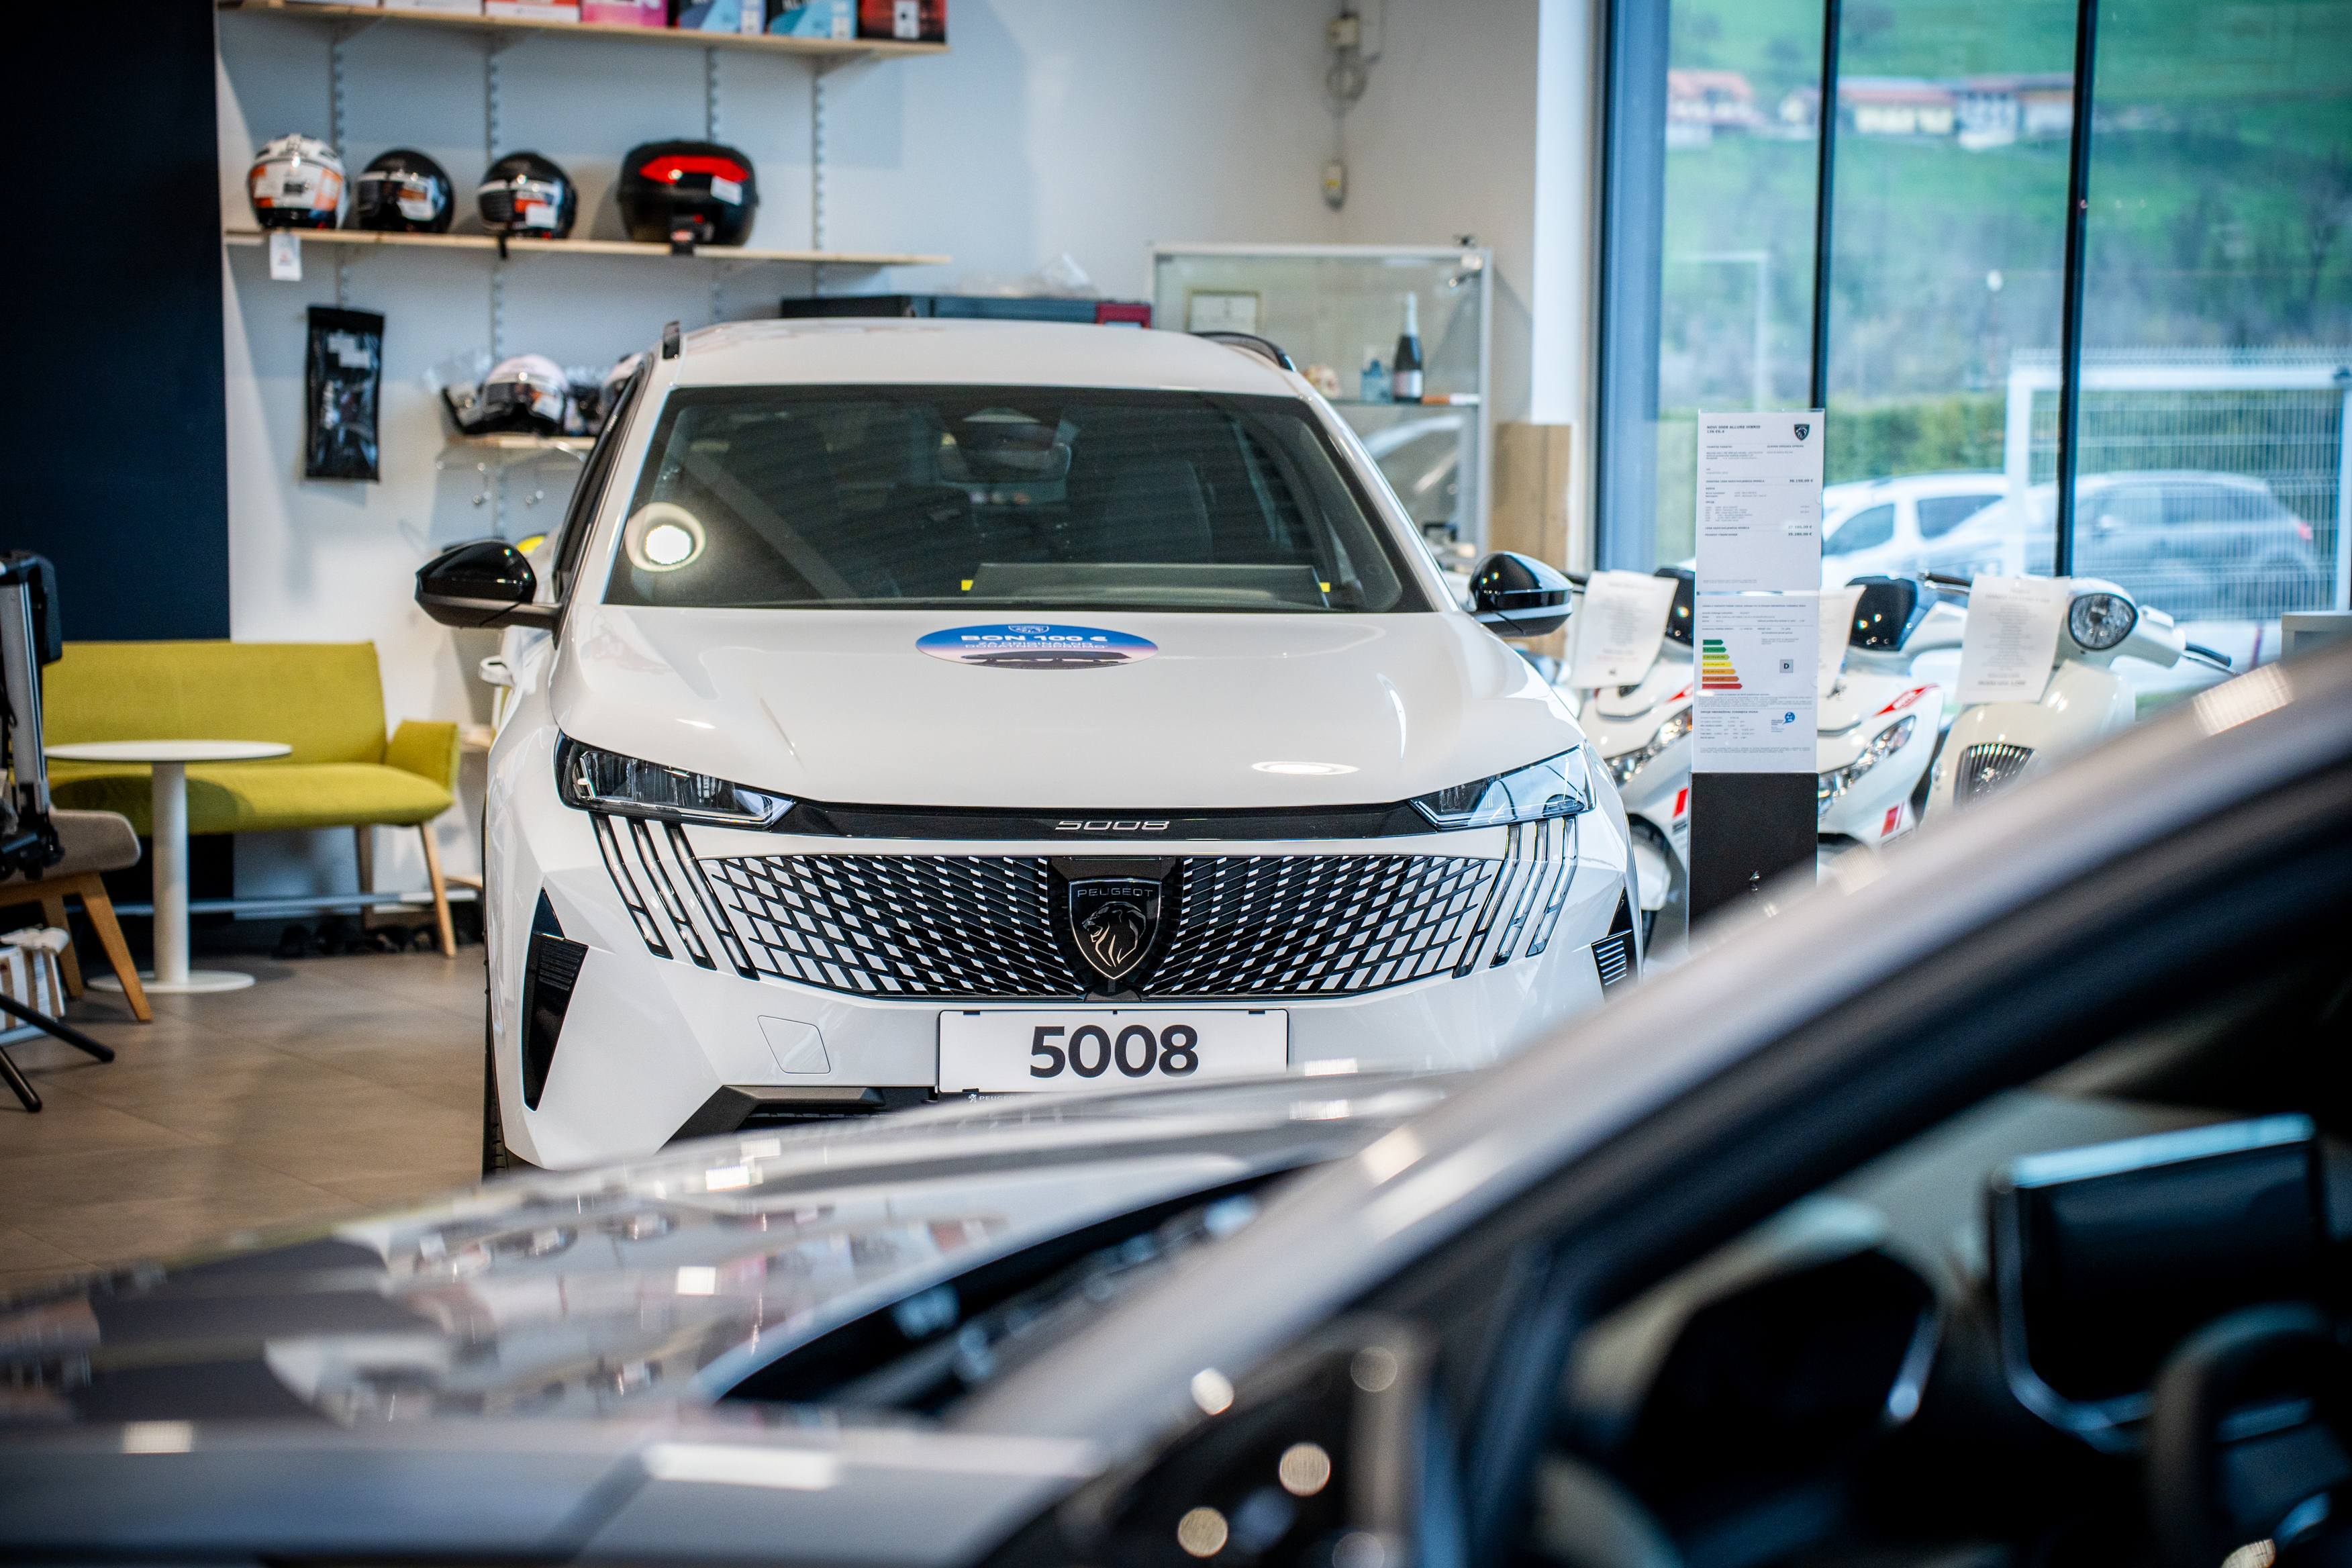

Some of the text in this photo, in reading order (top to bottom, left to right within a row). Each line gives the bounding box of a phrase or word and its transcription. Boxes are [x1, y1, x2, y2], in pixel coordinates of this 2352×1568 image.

[1055, 820, 1171, 831] 5008
[1077, 887, 1154, 898] PEUGEOT
[1029, 1024, 1199, 1079] 5008
